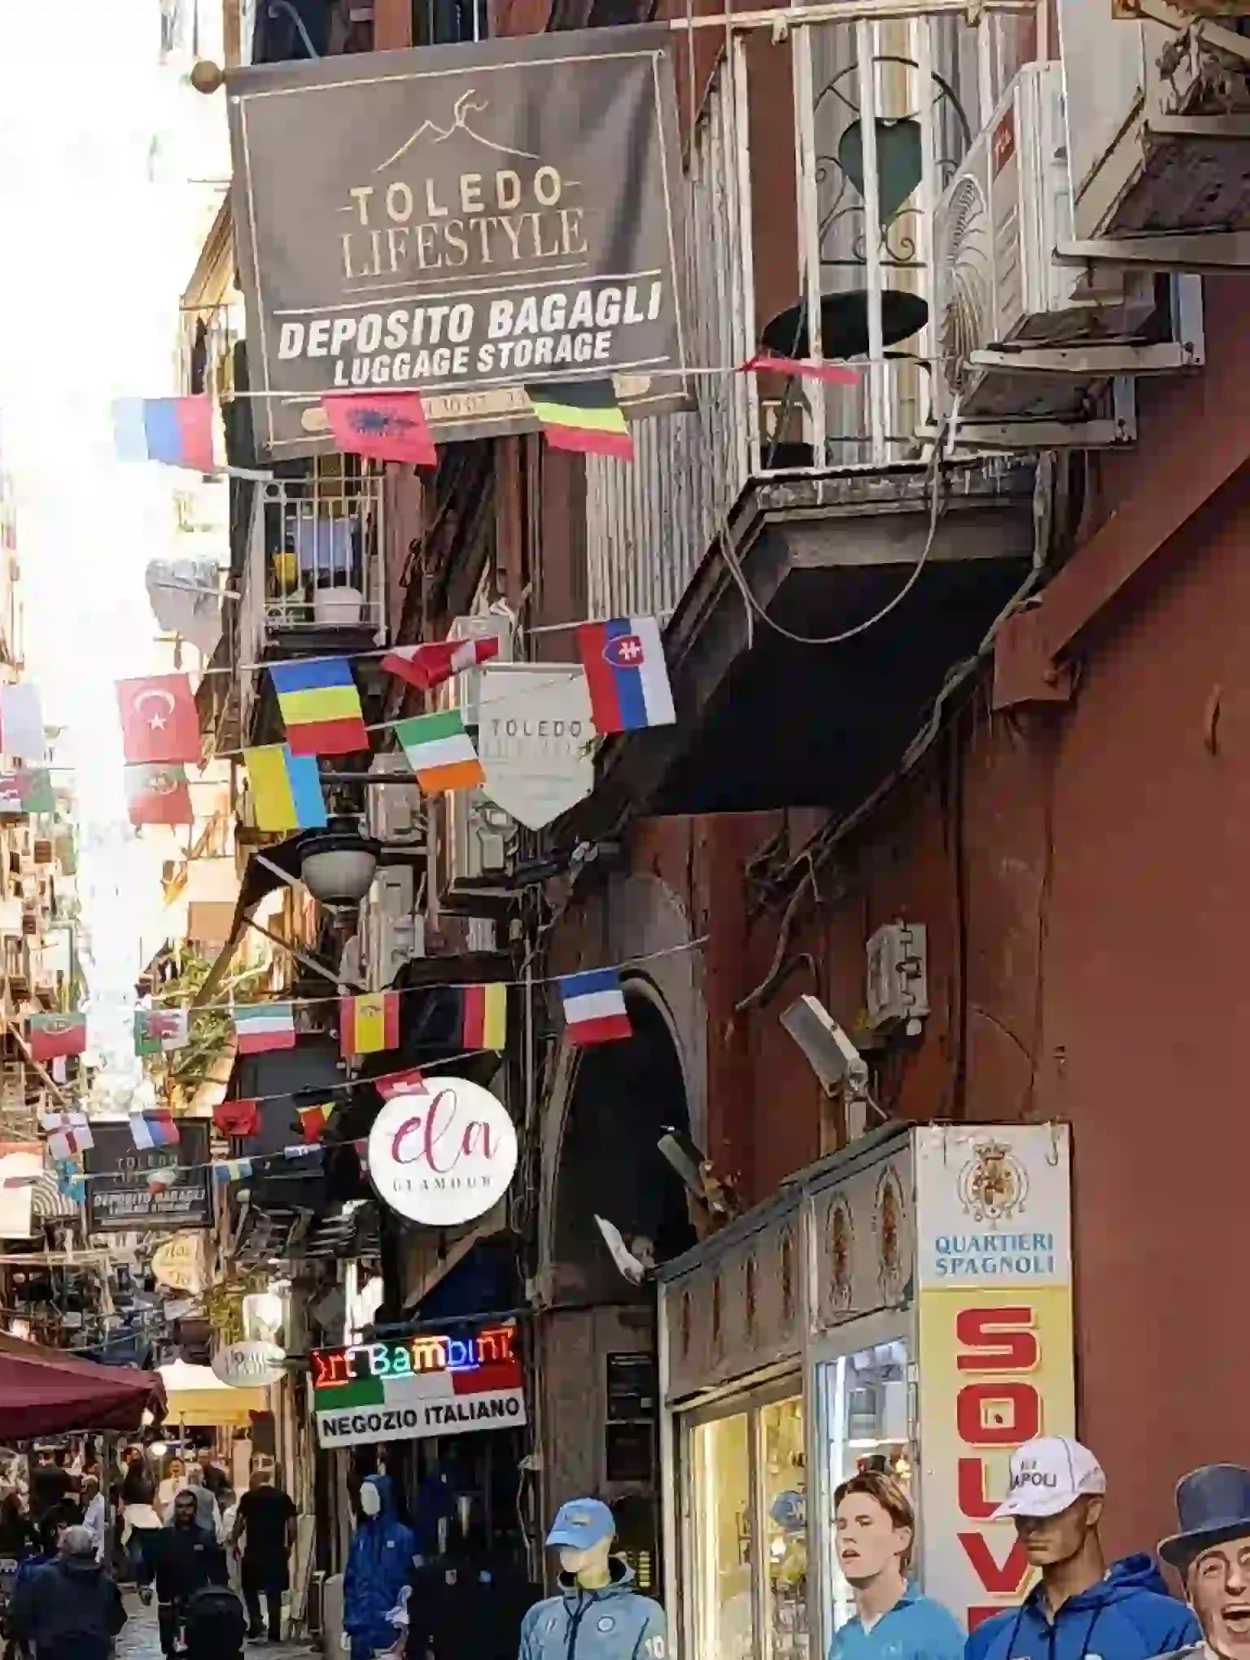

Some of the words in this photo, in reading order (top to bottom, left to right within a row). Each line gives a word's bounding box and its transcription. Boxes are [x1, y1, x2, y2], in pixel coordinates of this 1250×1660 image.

[350, 165, 562, 226] TOLEDO
[339, 207, 589, 280] LIFESTYLE
[278, 303, 475, 361] DEPOSITO
[488, 281, 662, 339] BAGAGLI
[333, 345, 469, 388] LUGGAGE
[476, 331, 613, 373] STORAGE
[491, 719, 583, 738] TOLEDO
[390, 1088, 501, 1174] ela
[934, 1233, 1054, 1256] QUARTIERI
[934, 1253, 1055, 1276] SPAGNOLI
[322, 1408, 418, 1437] NEGOZIO
[424, 1396, 520, 1426] ITALIANO
[956, 1306, 1042, 1632] SOLV
